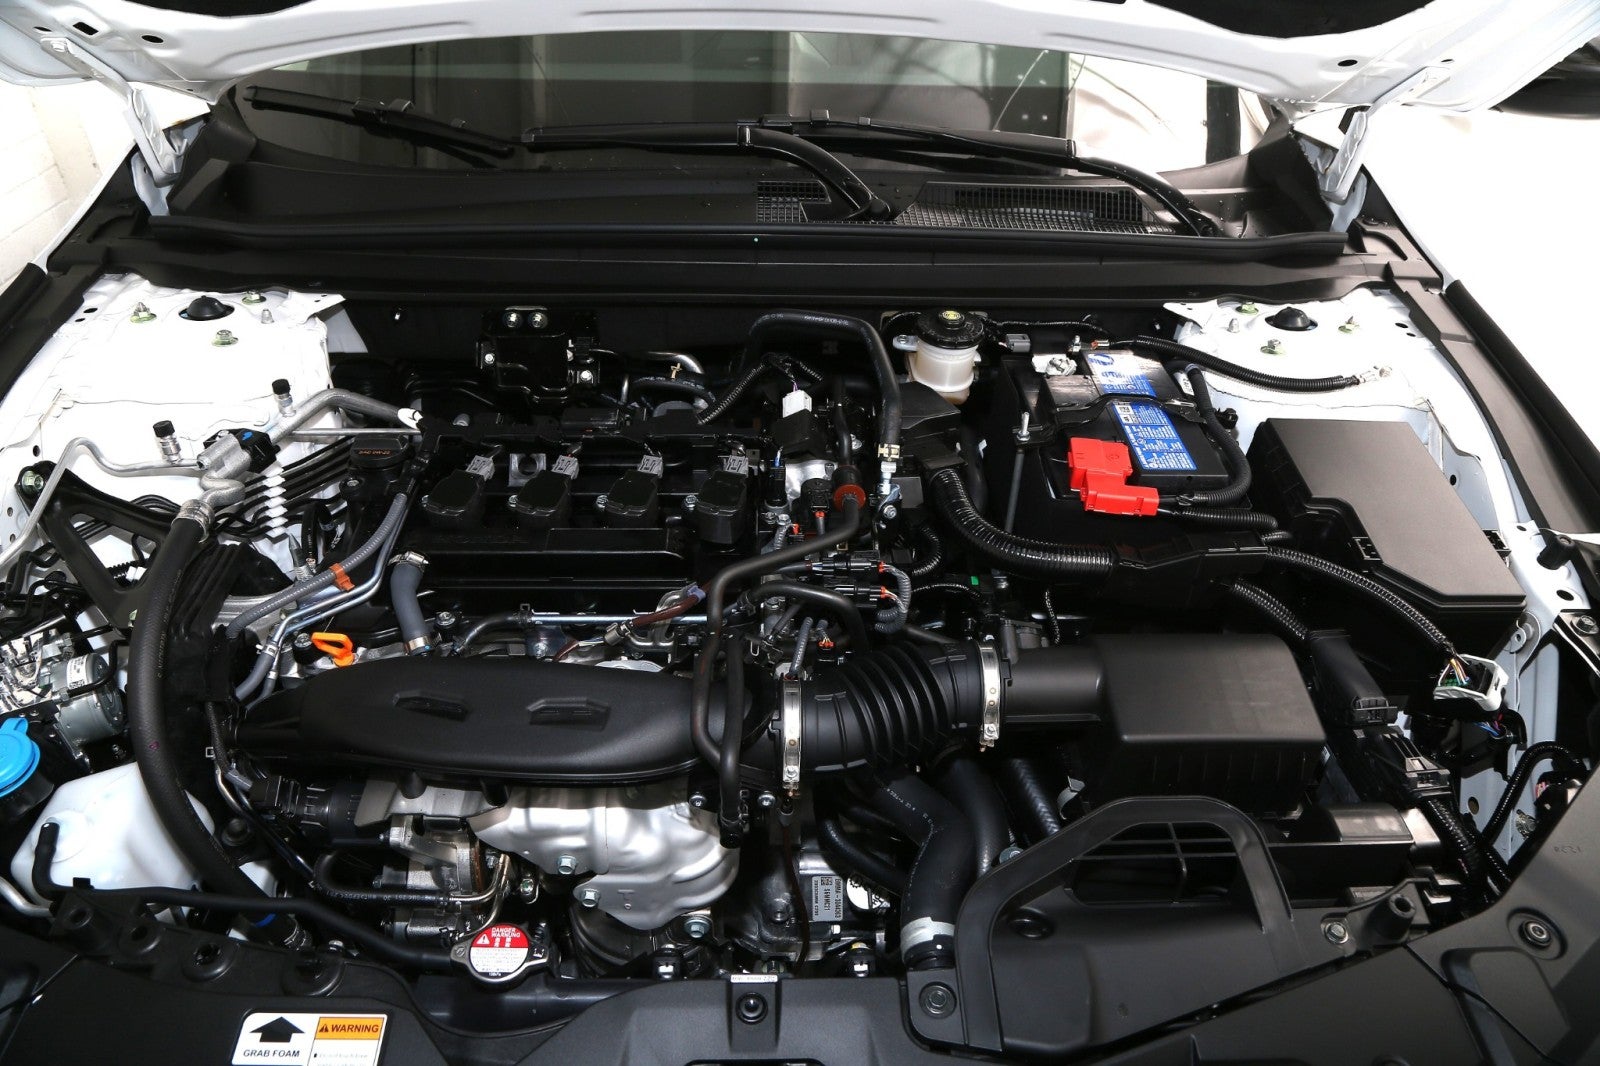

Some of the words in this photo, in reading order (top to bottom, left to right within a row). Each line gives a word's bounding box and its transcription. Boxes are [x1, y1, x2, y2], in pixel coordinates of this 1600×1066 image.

[331, 1024, 379, 1033] WARNING
[243, 1049, 270, 1057] GRAB
[272, 1049, 300, 1058] FOAM
